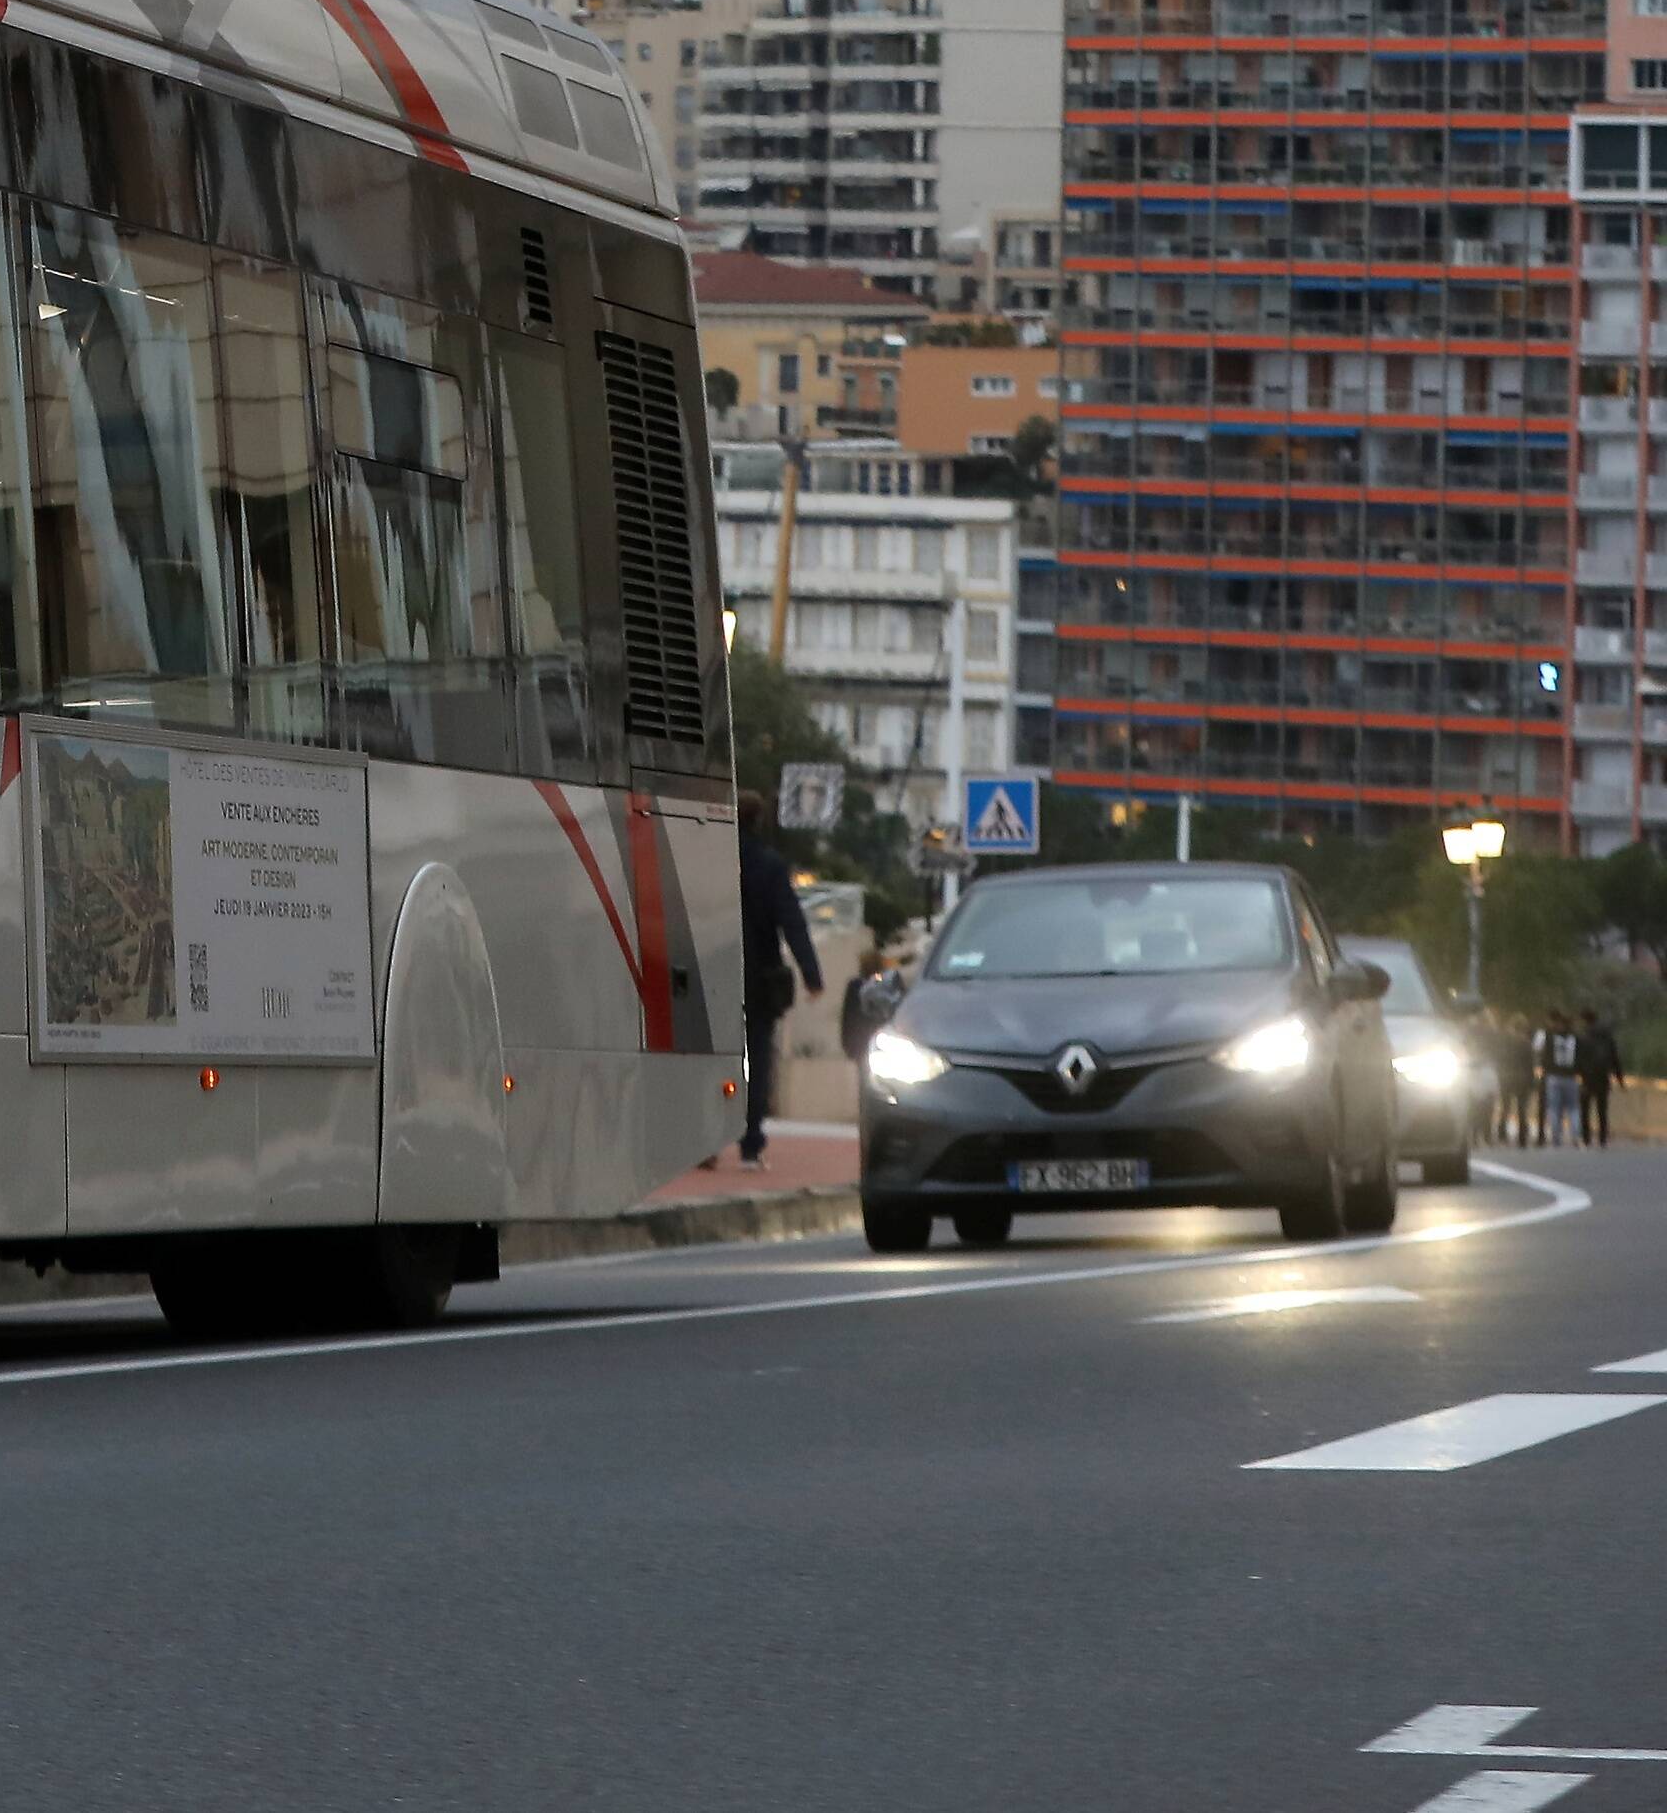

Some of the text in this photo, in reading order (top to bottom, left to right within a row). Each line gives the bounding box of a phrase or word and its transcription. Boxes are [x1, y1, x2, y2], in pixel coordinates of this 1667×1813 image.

[212, 762, 233, 783] DES
[236, 764, 270, 786] VENTES
[221, 801, 252, 821] VENTE
[253, 805, 271, 824] AUX
[202, 839, 220, 858] ART
[271, 843, 339, 866] CONTEMPORAIN
[250, 869, 297, 889] ET DESIGN
[214, 899, 240, 916] JEUDI
[253, 901, 288, 918] JANVIER
[290, 902, 311, 919] 2023
